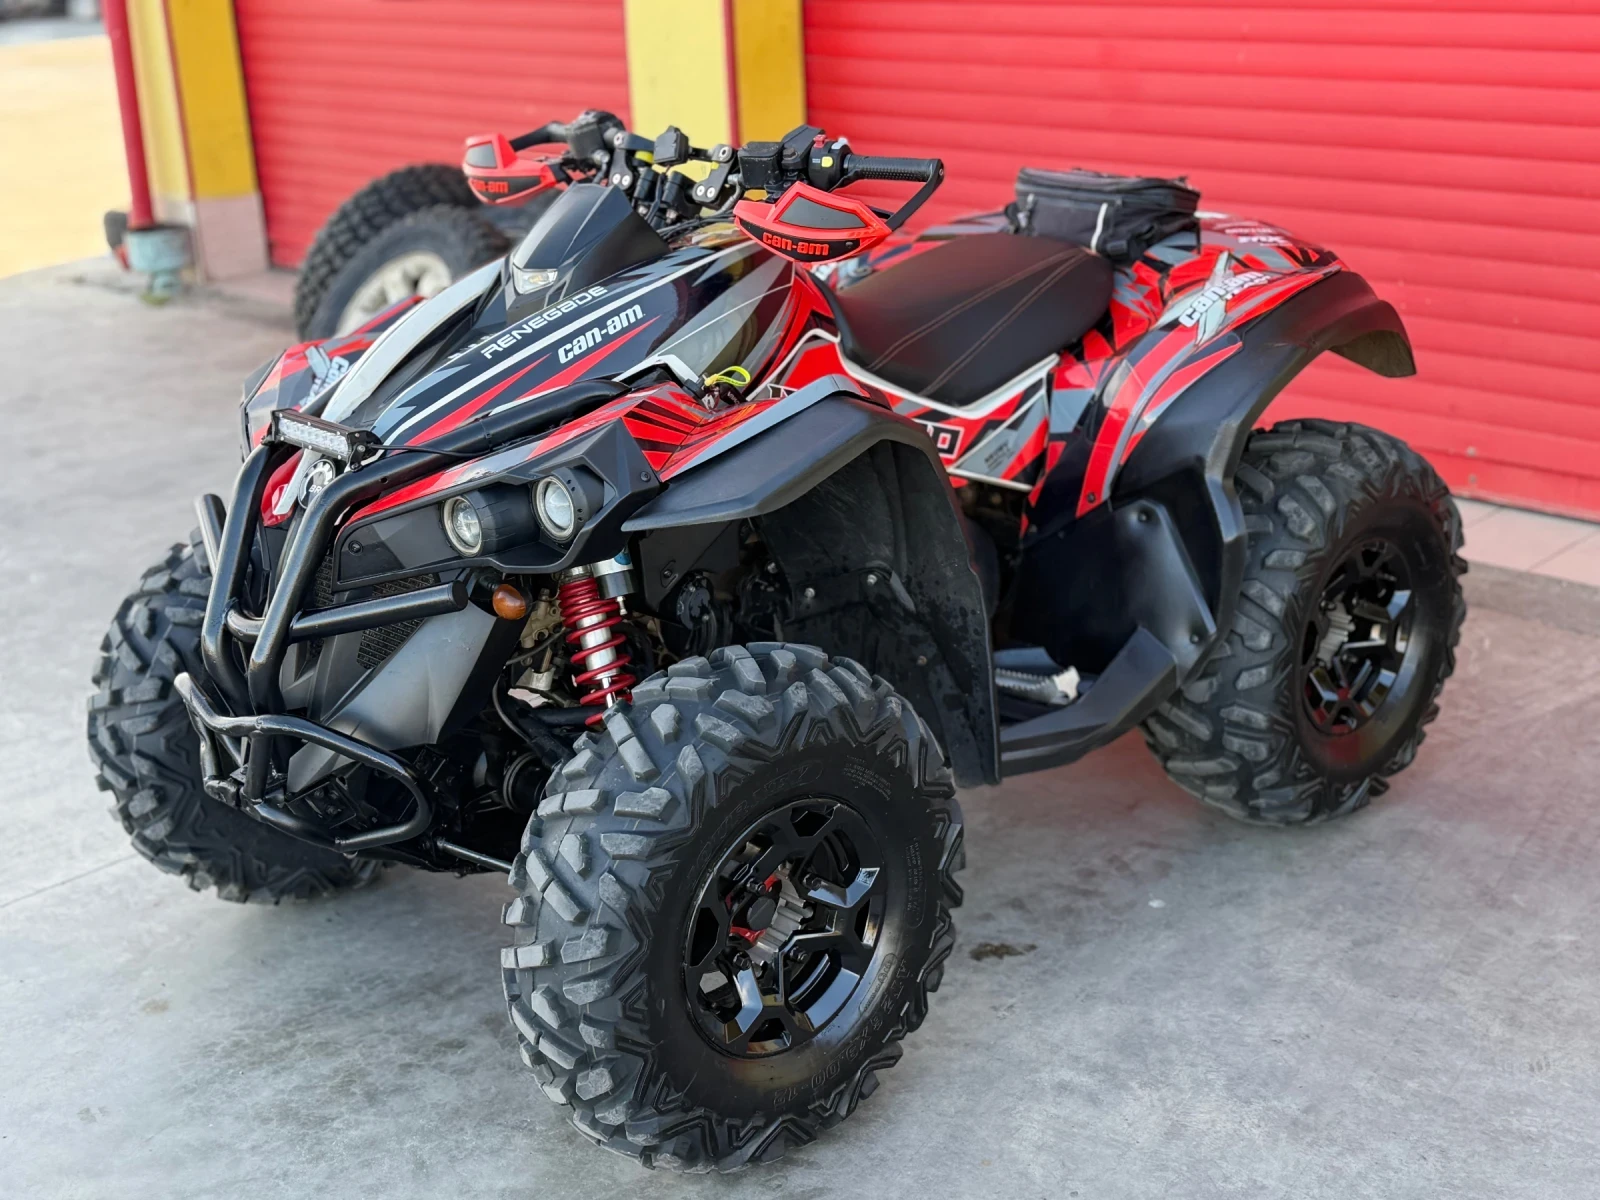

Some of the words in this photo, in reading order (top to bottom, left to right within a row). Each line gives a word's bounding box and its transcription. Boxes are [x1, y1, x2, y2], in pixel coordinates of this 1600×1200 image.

[471, 179, 508, 193] an-am
[763, 231, 829, 256] can-am
[1178, 271, 1264, 328] can-am
[480, 285, 608, 360] RENEGADE
[557, 303, 644, 364] can-am
[308, 484, 323, 494] BR
